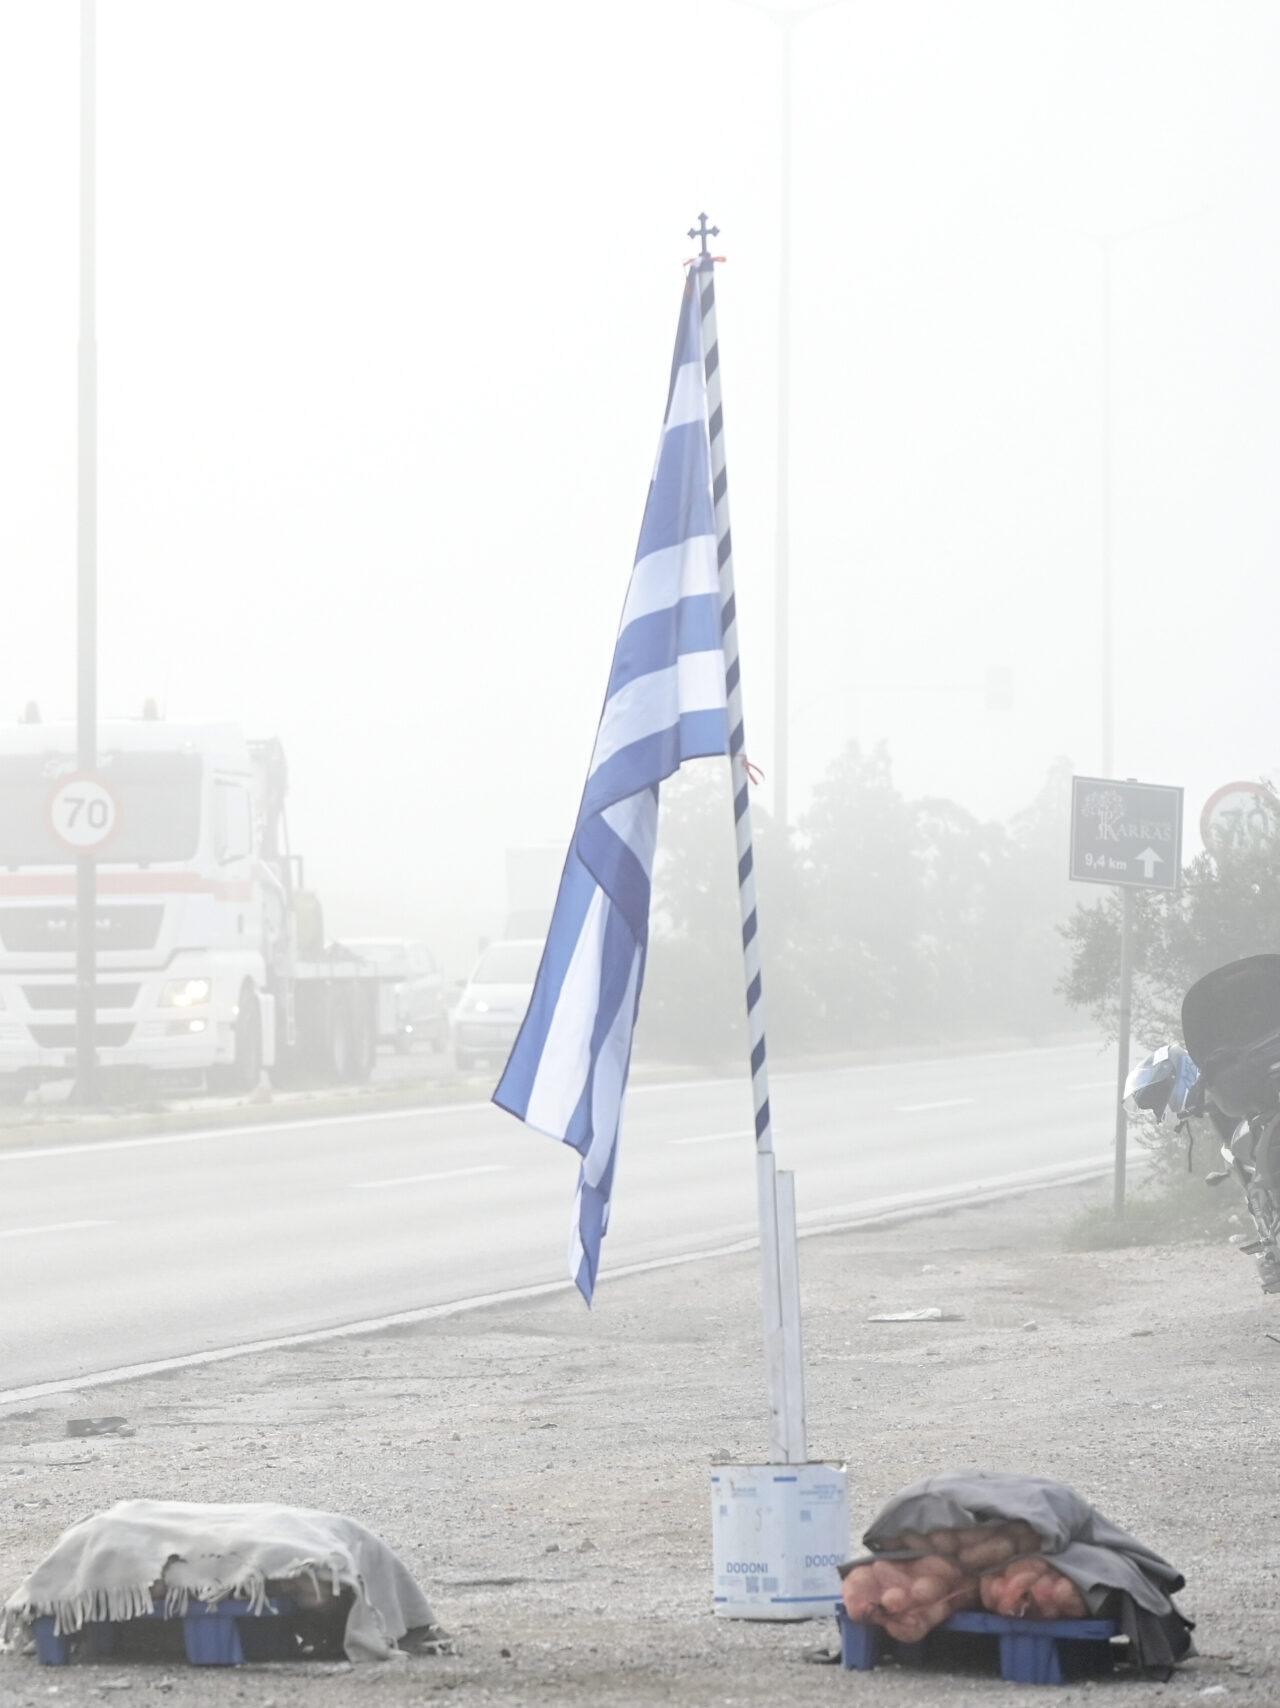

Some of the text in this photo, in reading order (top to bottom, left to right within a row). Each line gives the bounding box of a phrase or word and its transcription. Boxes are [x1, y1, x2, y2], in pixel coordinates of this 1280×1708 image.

[63, 797, 109, 829] 70
[1084, 852, 1127, 870] 9,4 km
[726, 1562, 769, 1574] DODONI
